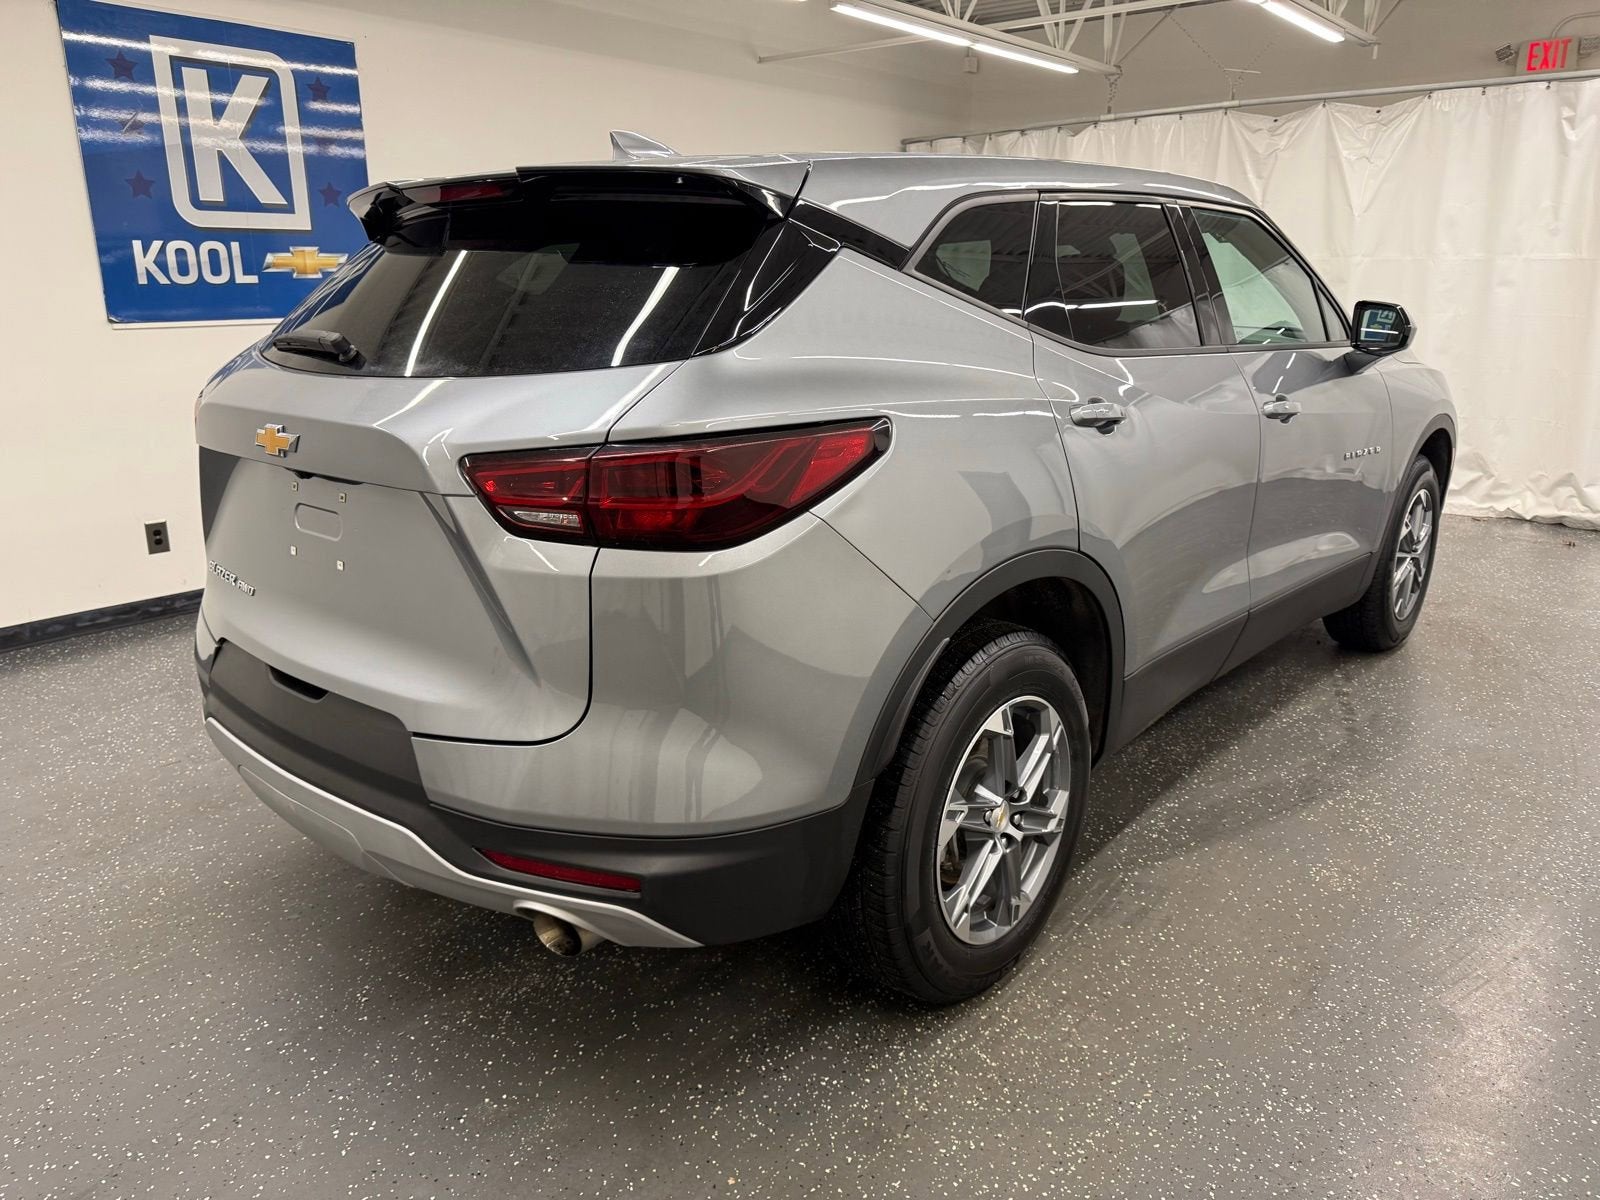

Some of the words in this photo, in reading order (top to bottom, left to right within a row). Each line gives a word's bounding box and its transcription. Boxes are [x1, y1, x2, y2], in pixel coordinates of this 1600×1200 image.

[1526, 38, 1573, 71] EXIT
[182, 66, 288, 205] K
[132, 239, 259, 284] KOOL
[209, 560, 237, 586] BLAZER
